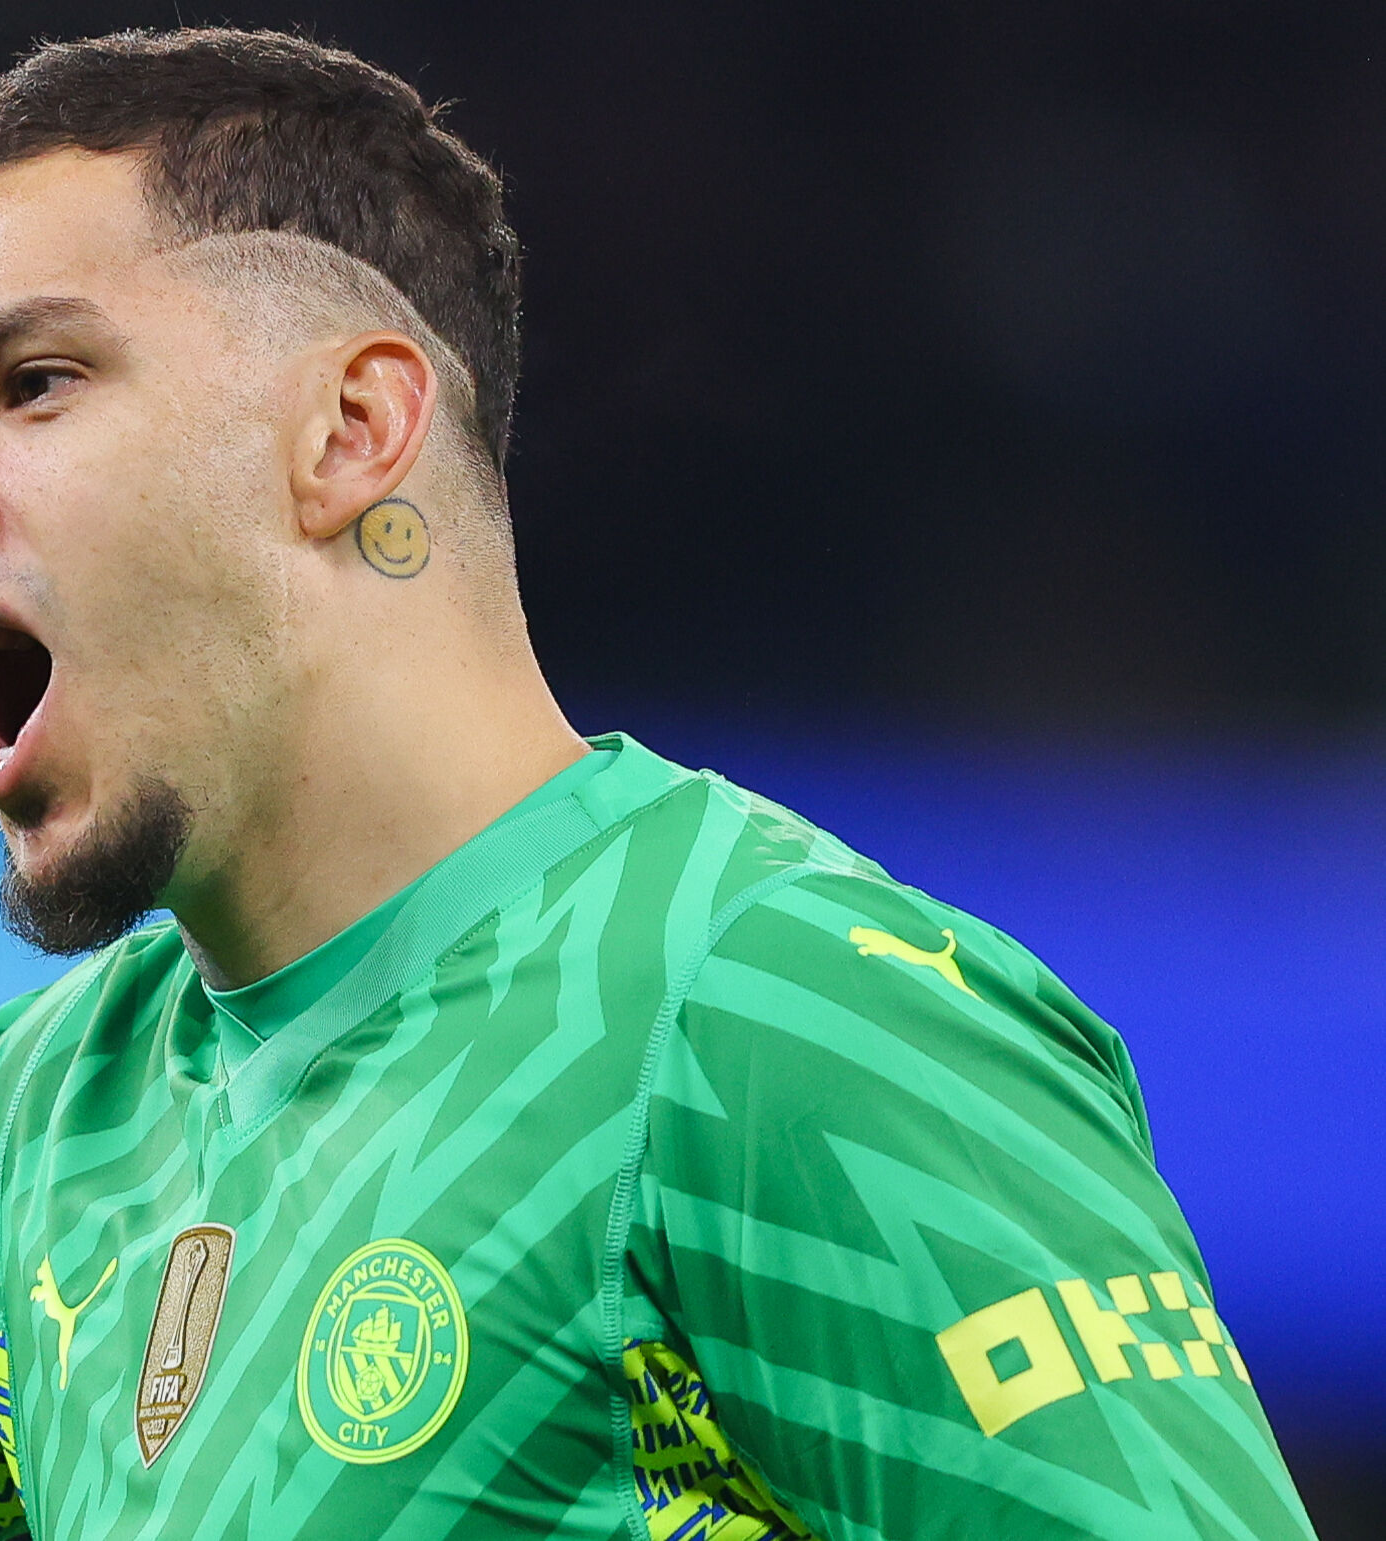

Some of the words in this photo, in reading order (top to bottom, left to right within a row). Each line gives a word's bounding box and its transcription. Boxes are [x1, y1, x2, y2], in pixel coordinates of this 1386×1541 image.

[326, 1256, 449, 1329] MANCHESTER
[433, 1352, 452, 1365] 94
[150, 1375, 179, 1404] FIFA
[338, 1422, 389, 1446] CITY
